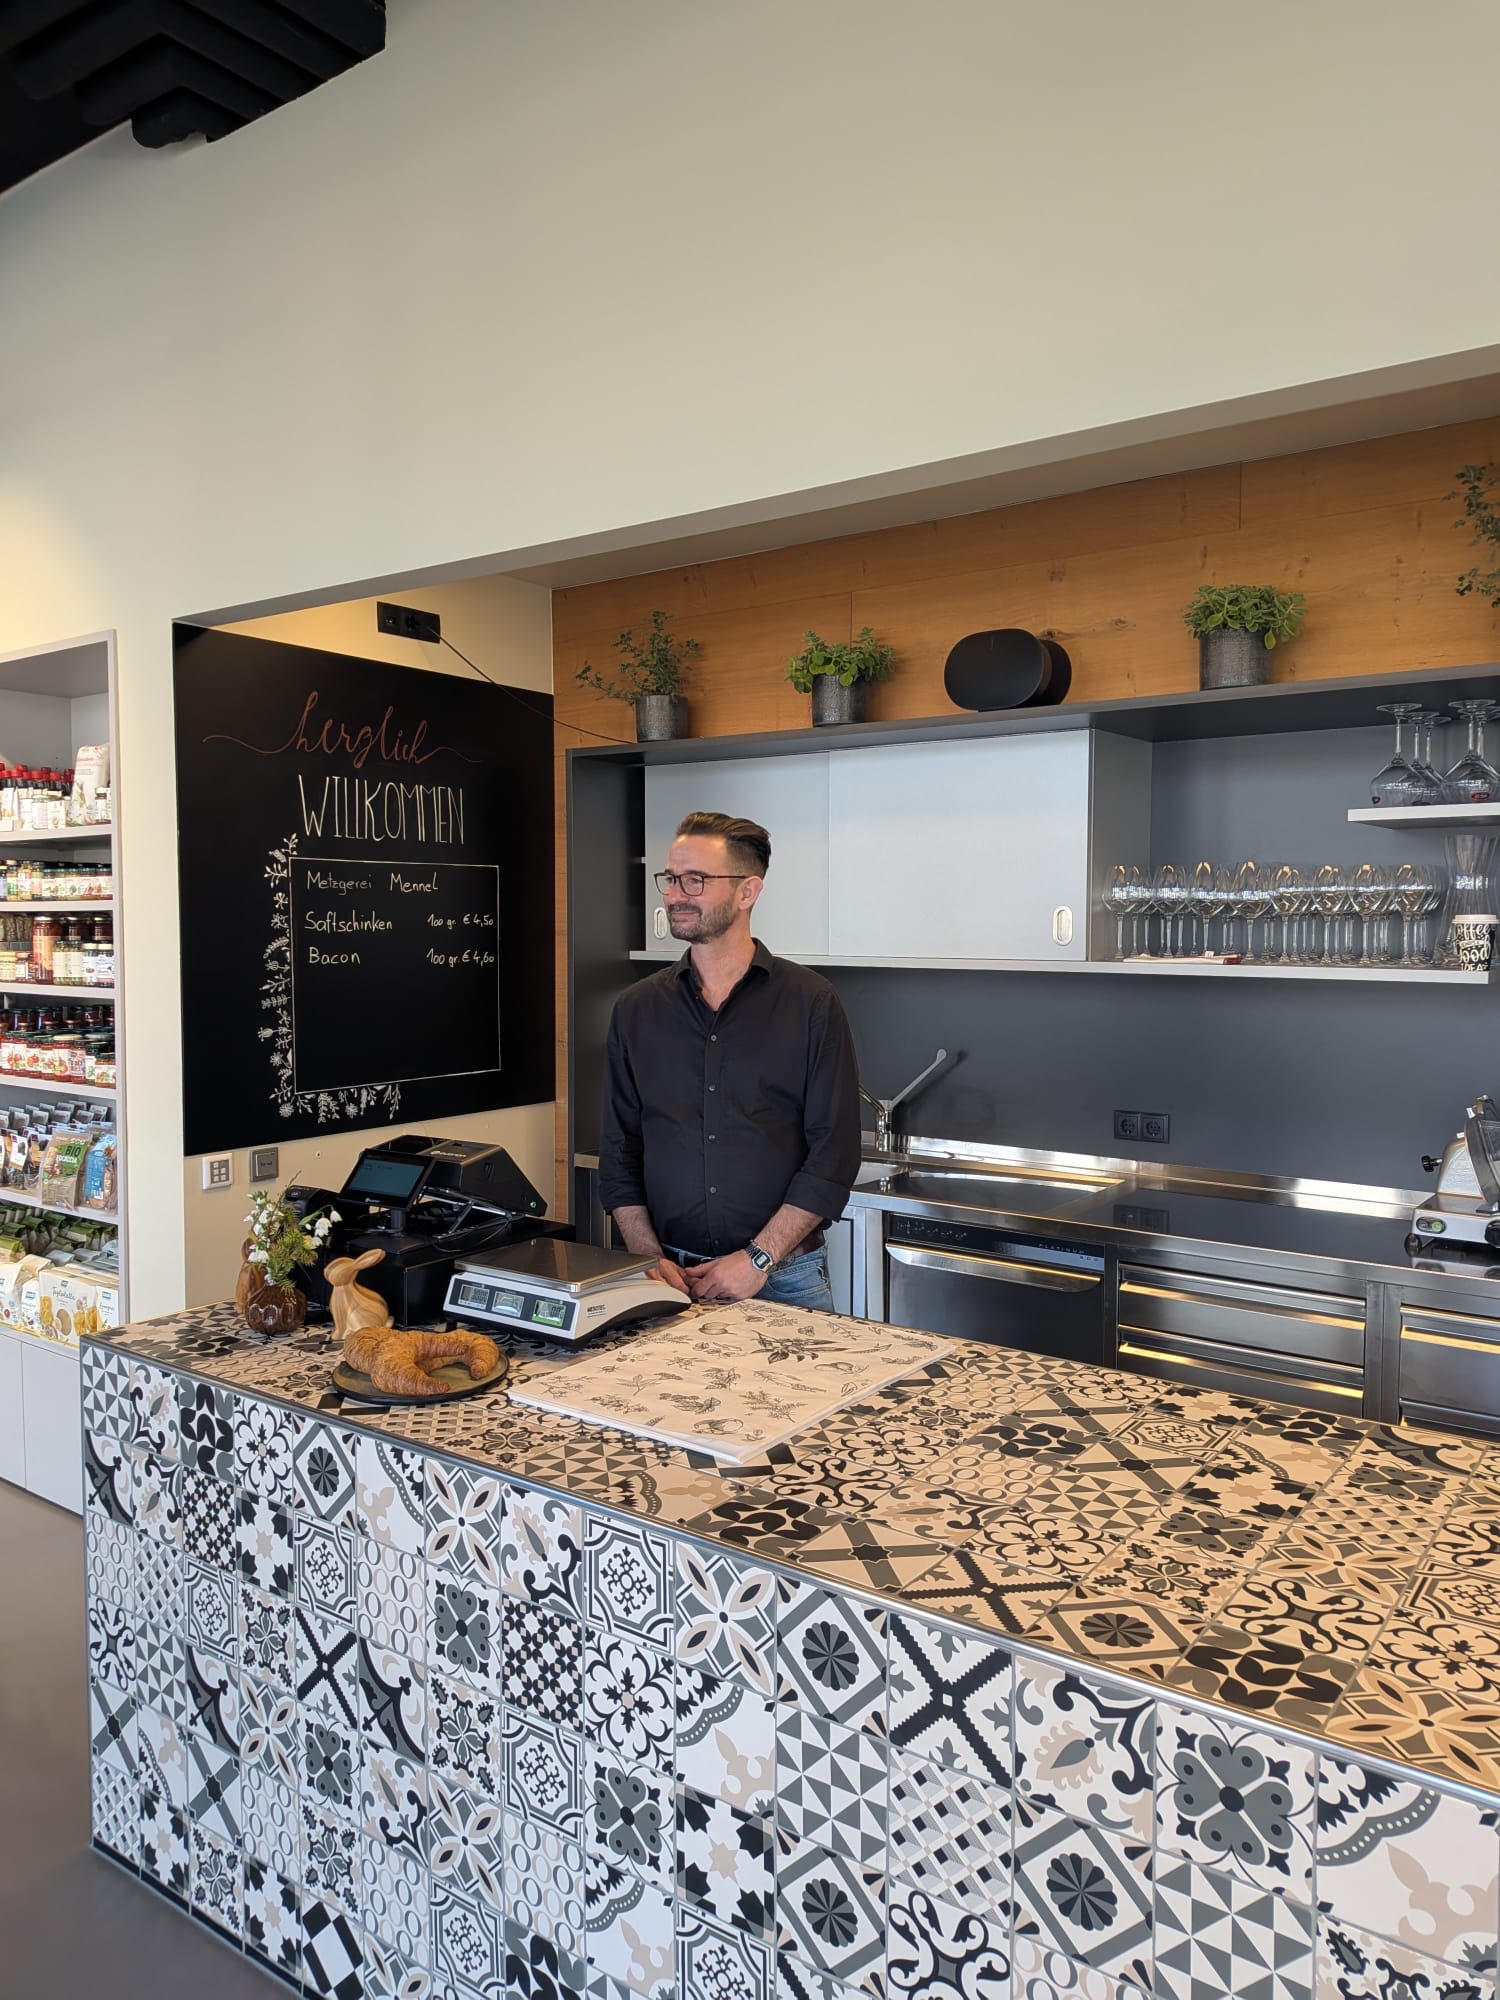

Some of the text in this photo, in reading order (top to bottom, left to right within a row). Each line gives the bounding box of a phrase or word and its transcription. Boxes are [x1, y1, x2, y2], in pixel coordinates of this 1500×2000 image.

[297, 773, 465, 845] WILLKOMMEN
[306, 869, 439, 896] Metzgerei Mennel
[303, 908, 393, 934] Saftschinken
[427, 913, 444, 927] 100
[308, 946, 361, 965] Bacon
[426, 947, 445, 965] 100
[65, 1145, 81, 1157] BIO
